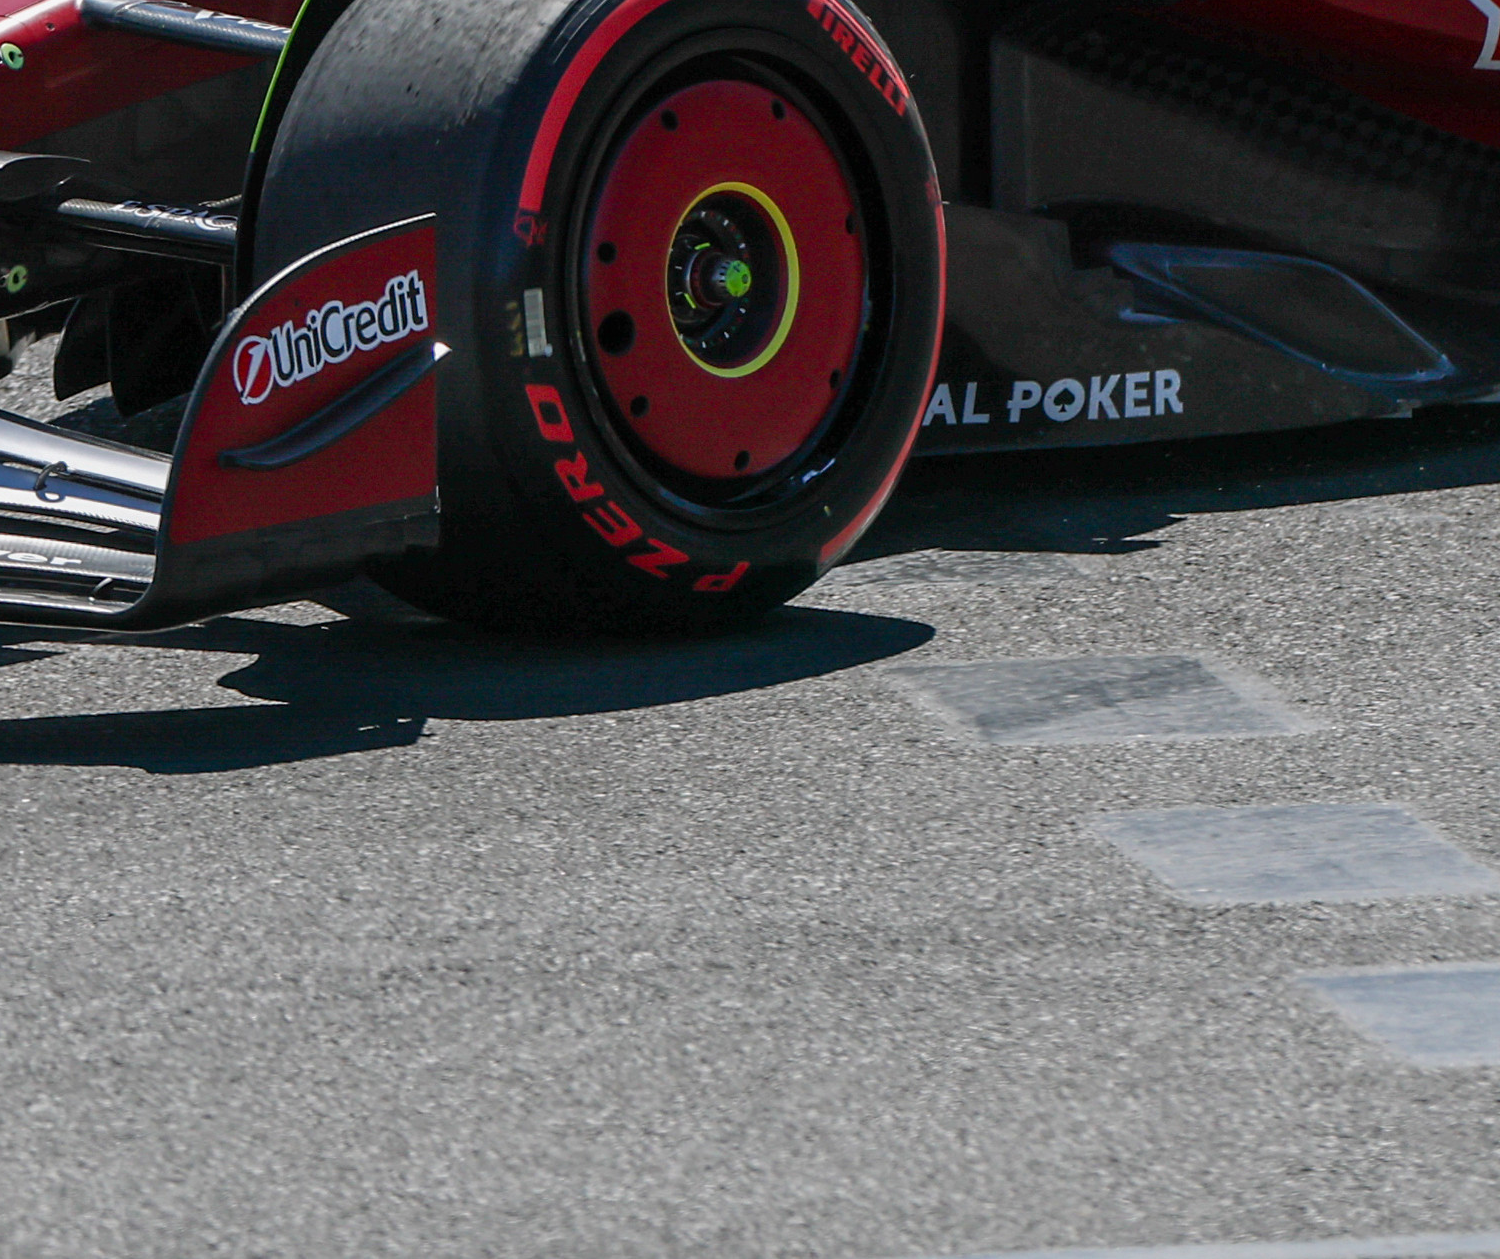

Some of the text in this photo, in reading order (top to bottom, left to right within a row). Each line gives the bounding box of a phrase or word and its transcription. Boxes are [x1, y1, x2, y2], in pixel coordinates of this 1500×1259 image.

[268, 269, 429, 387] UniCredit
[922, 368, 1184, 427] AL POKER
[525, 382, 691, 579] ZERO
